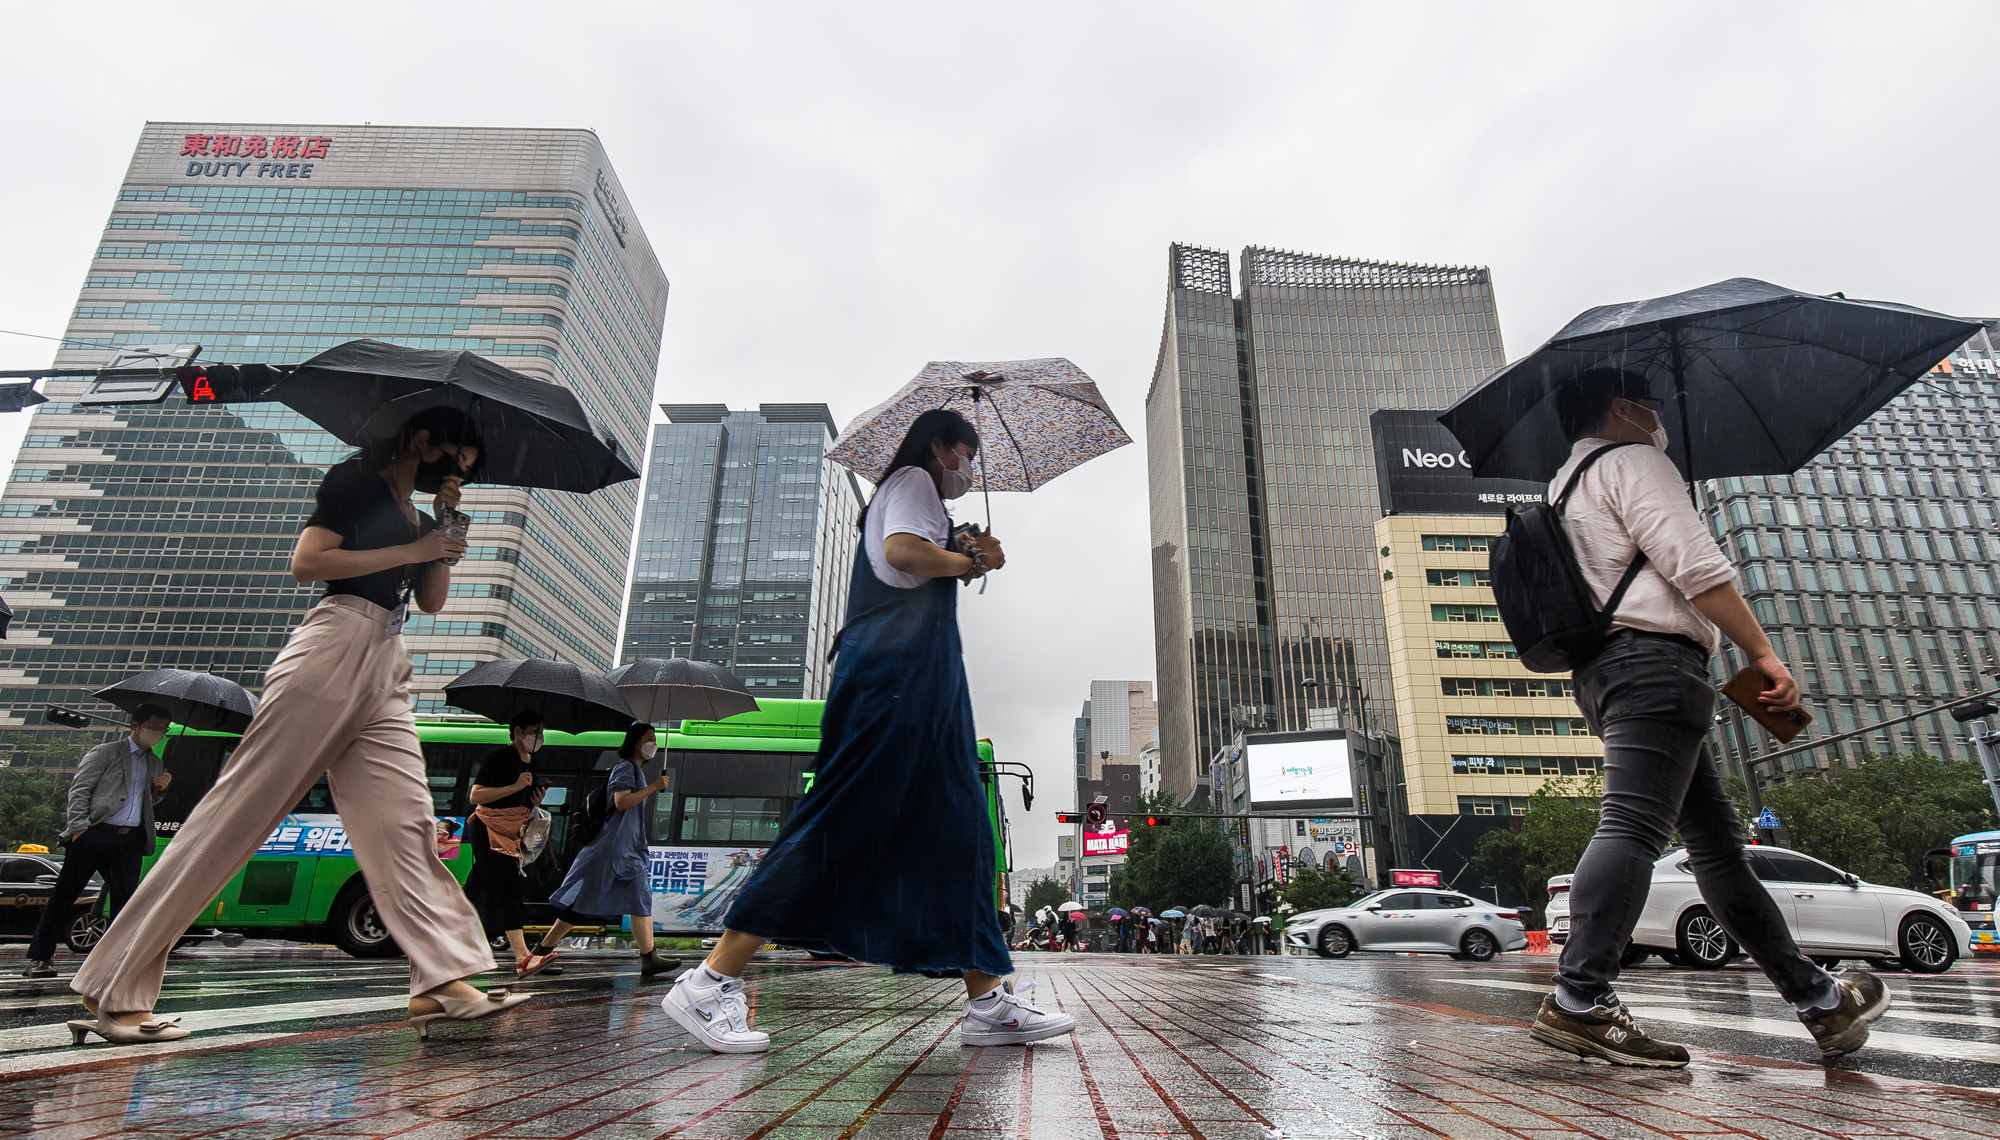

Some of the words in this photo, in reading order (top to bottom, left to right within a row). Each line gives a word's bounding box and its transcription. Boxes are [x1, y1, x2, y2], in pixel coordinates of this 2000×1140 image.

[185, 161, 250, 178] DUTY
[257, 162, 314, 179] FREE
[1402, 448, 1456, 468] Neo
[1478, 493, 1505, 503] 새로운
[1507, 493, 1542, 504] 라이프의
[1446, 718, 1488, 728] 이비인후과
[1498, 721, 1511, 729] Kim
[1468, 757, 1495, 767] 피부과
[154, 821, 184, 831] 유성운
[303, 827, 353, 852] 워터
[1086, 838, 1108, 851] MATA
[1108, 837, 1127, 849] HARI
[690, 851, 709, 860] 가득!!
[1343, 841, 1359, 856] 약
[648, 860, 708, 878] 마운트
[1604, 1025, 1628, 1044] N
